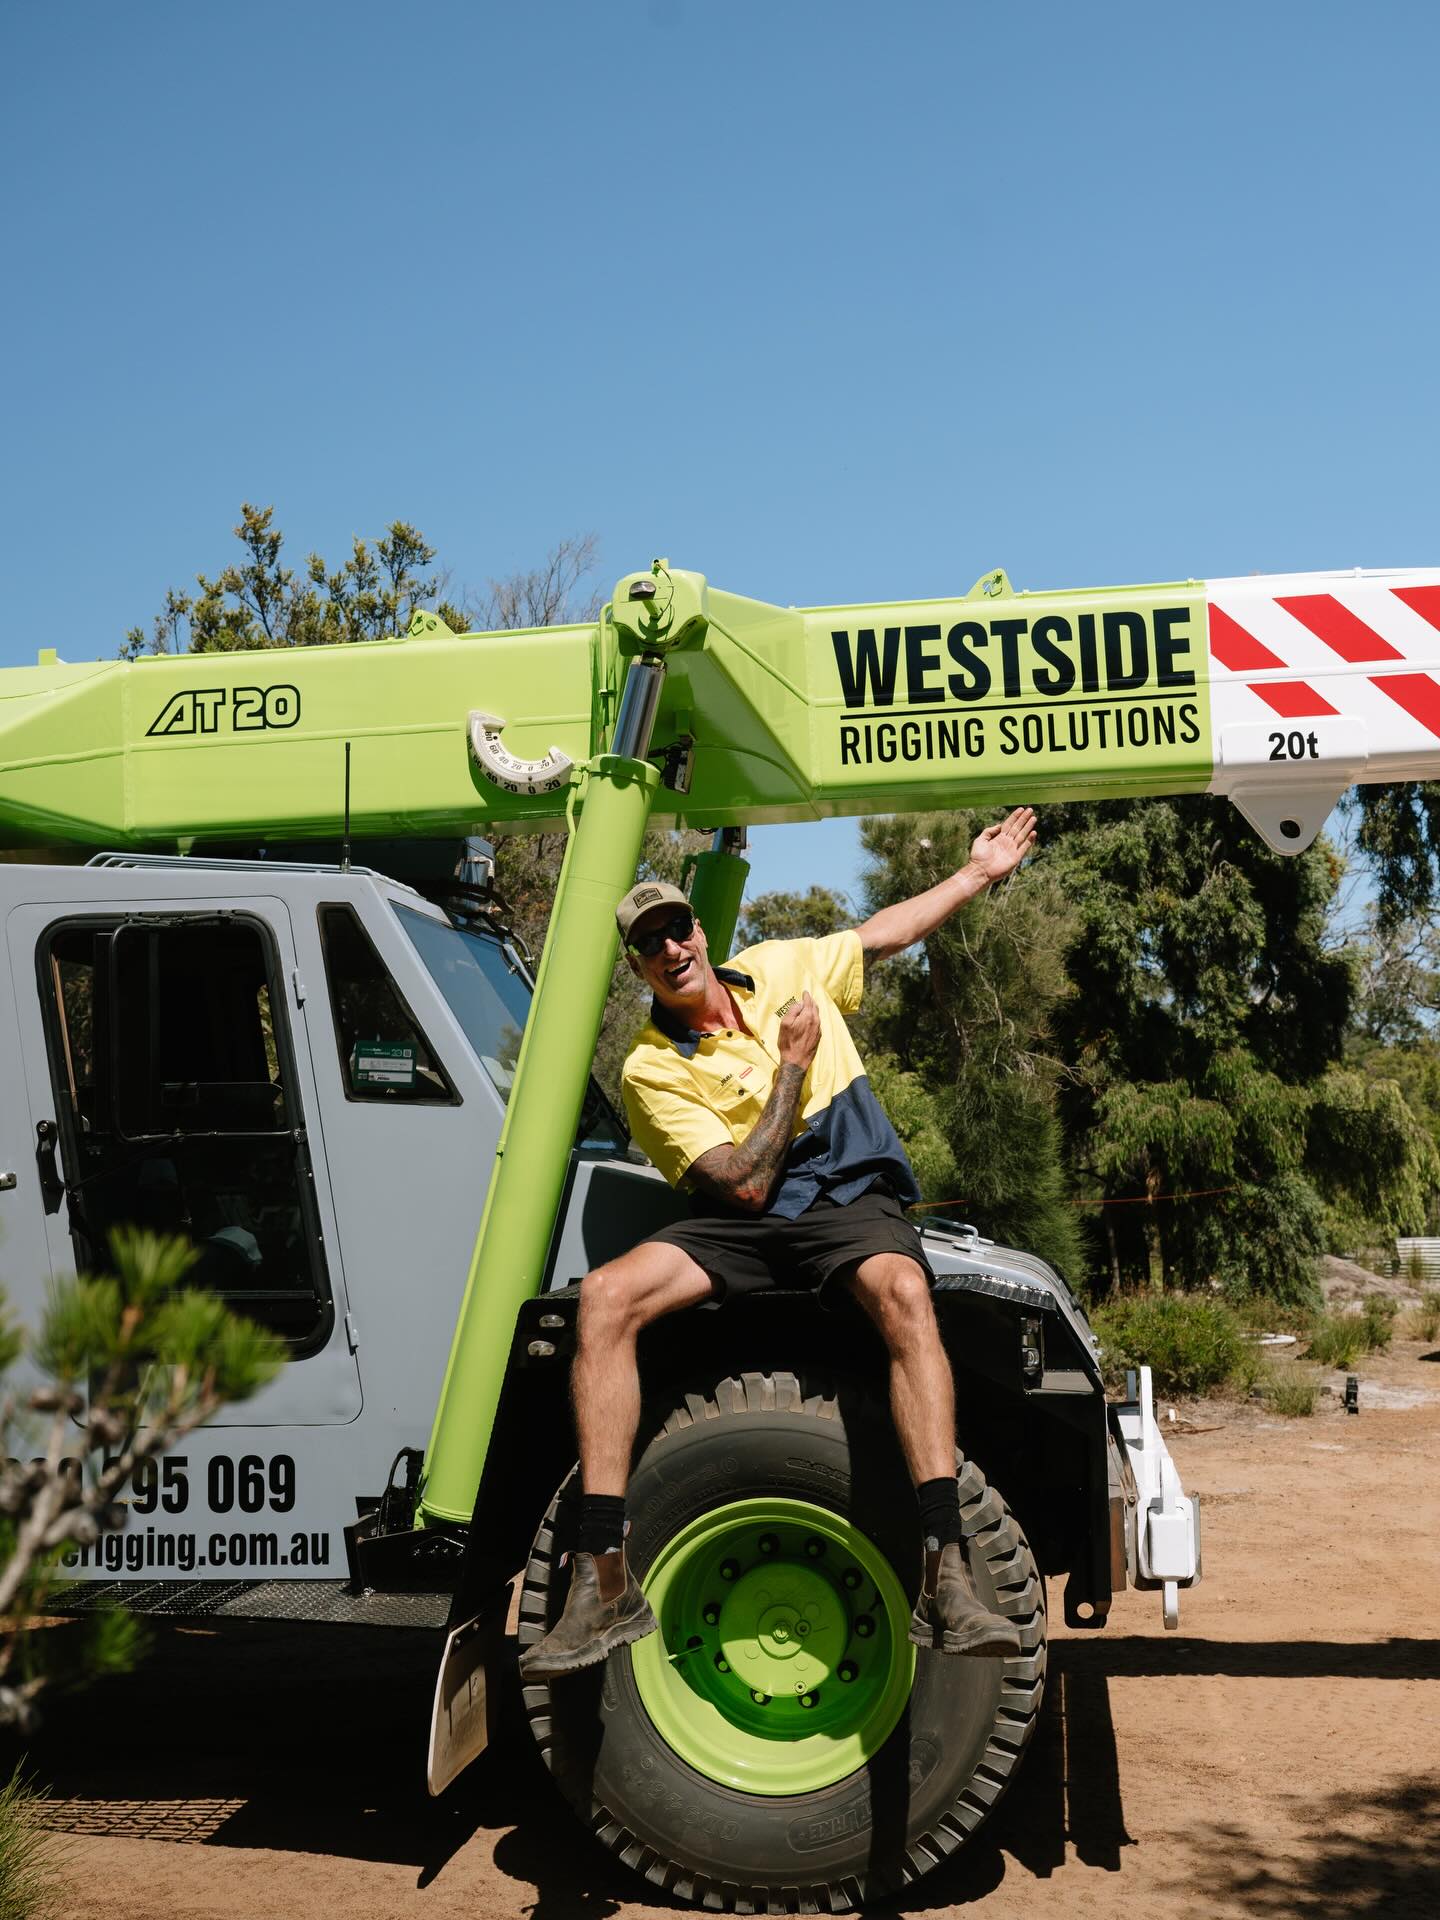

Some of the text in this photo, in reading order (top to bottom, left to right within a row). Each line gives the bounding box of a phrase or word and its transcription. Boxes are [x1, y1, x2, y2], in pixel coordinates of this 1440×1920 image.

[831, 607, 1195, 708] WESTSIDE
[144, 685, 300, 737] AT 20
[840, 704, 1201, 765] RIGGING SOLUTIONS
[1268, 730, 1319, 761] 20t
[504, 781, 518, 793] 20
[528, 785, 536, 794] 0
[207, 1454, 296, 1514] 069
